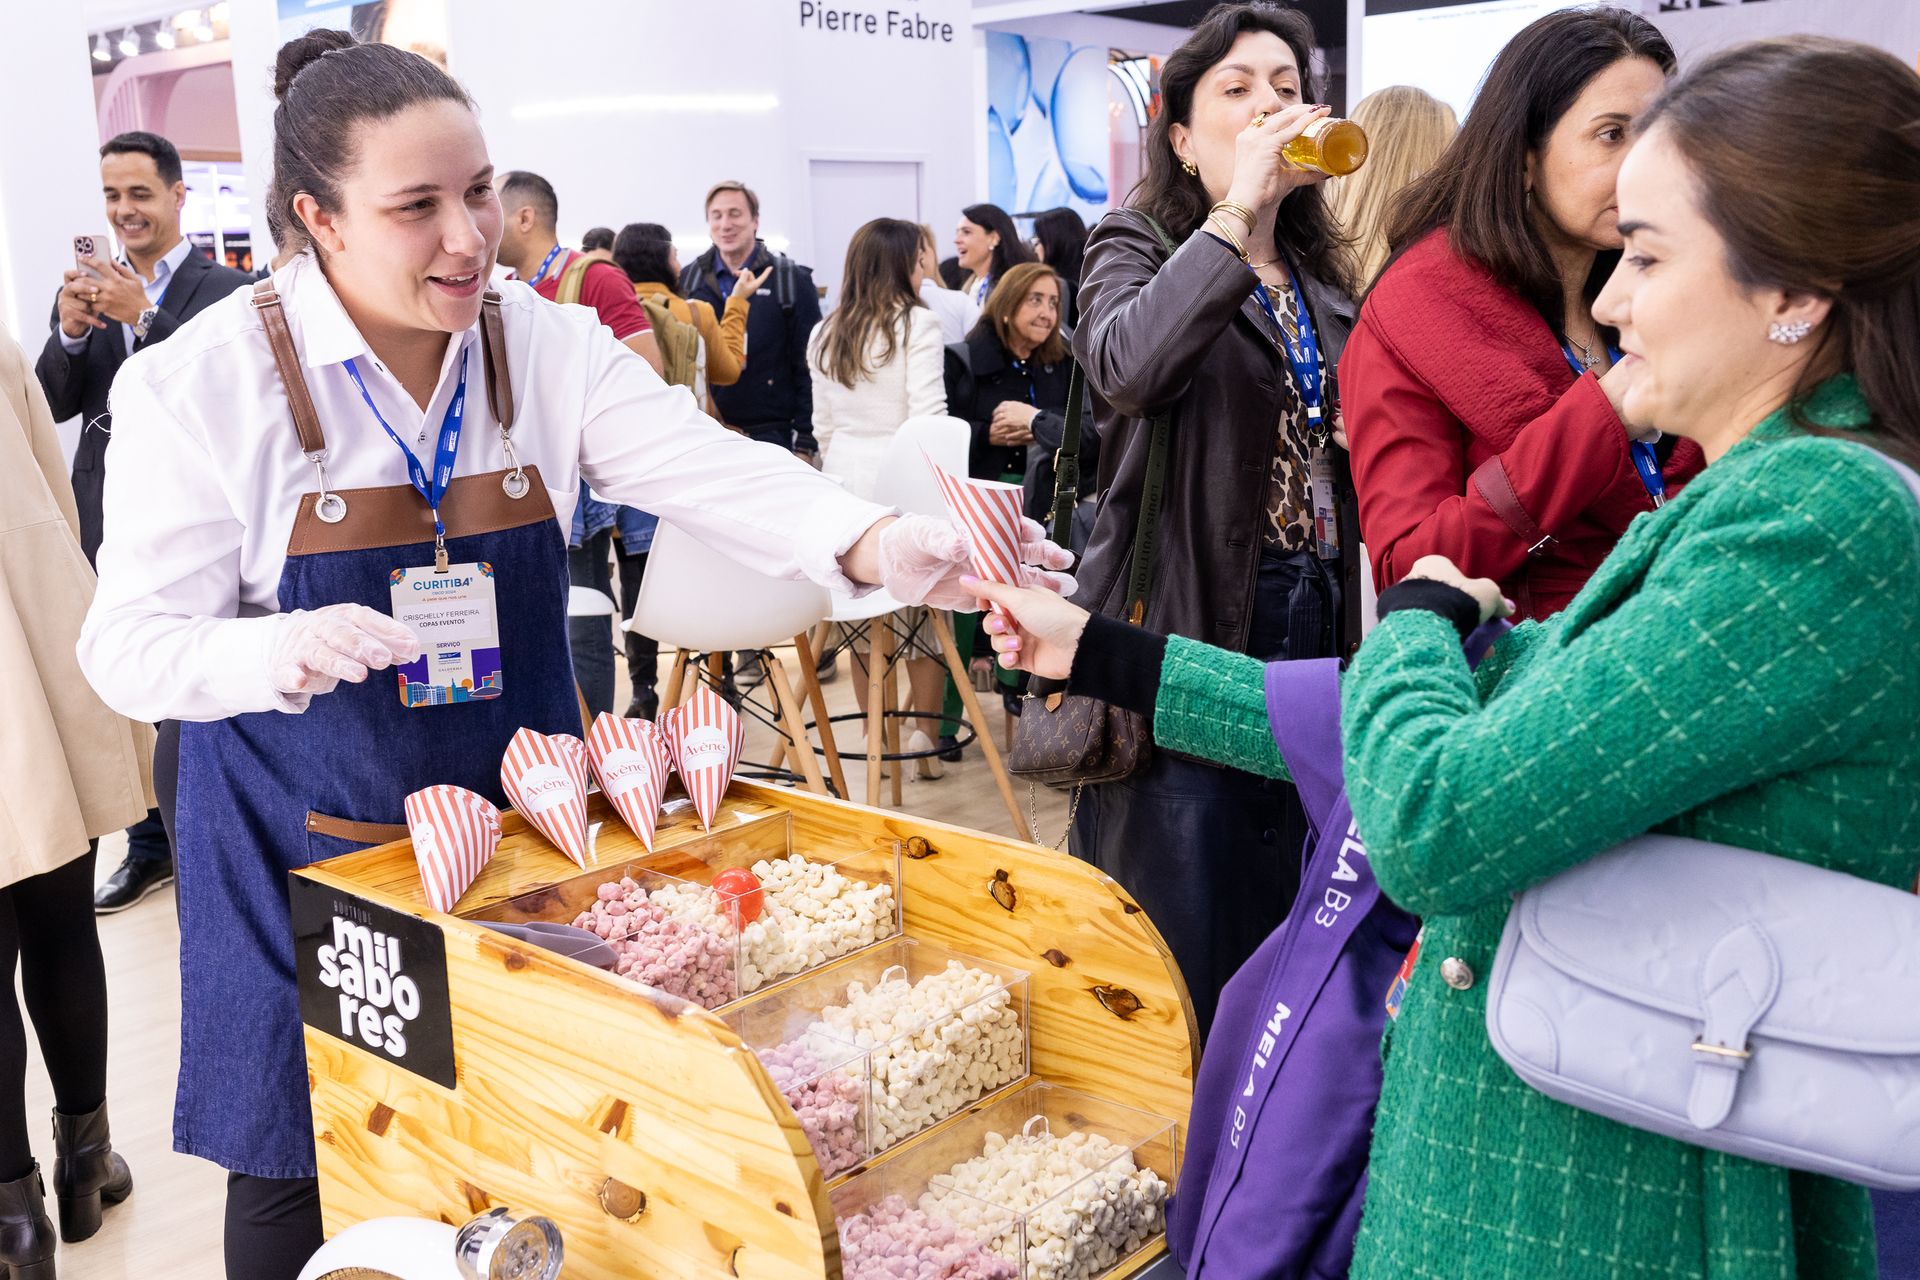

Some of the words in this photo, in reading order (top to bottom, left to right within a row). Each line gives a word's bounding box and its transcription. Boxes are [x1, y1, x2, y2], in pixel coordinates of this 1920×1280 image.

[800, 0, 877, 35] Pierre
[887, 10, 954, 42] Fabre
[403, 612, 445, 621] CRISCHELLY
[446, 609, 480, 617] FERREIRA
[439, 618, 465, 627] EVENTOS
[436, 641, 461, 649] SERVIÇO
[686, 742, 726, 756] Avène
[526, 779, 570, 803] Avène
[1315, 887, 1351, 929] B3
[332, 915, 403, 979] mil
[338, 993, 408, 1058] res
[1243, 1001, 1291, 1097] MELA
[1230, 1105, 1247, 1149] B3
